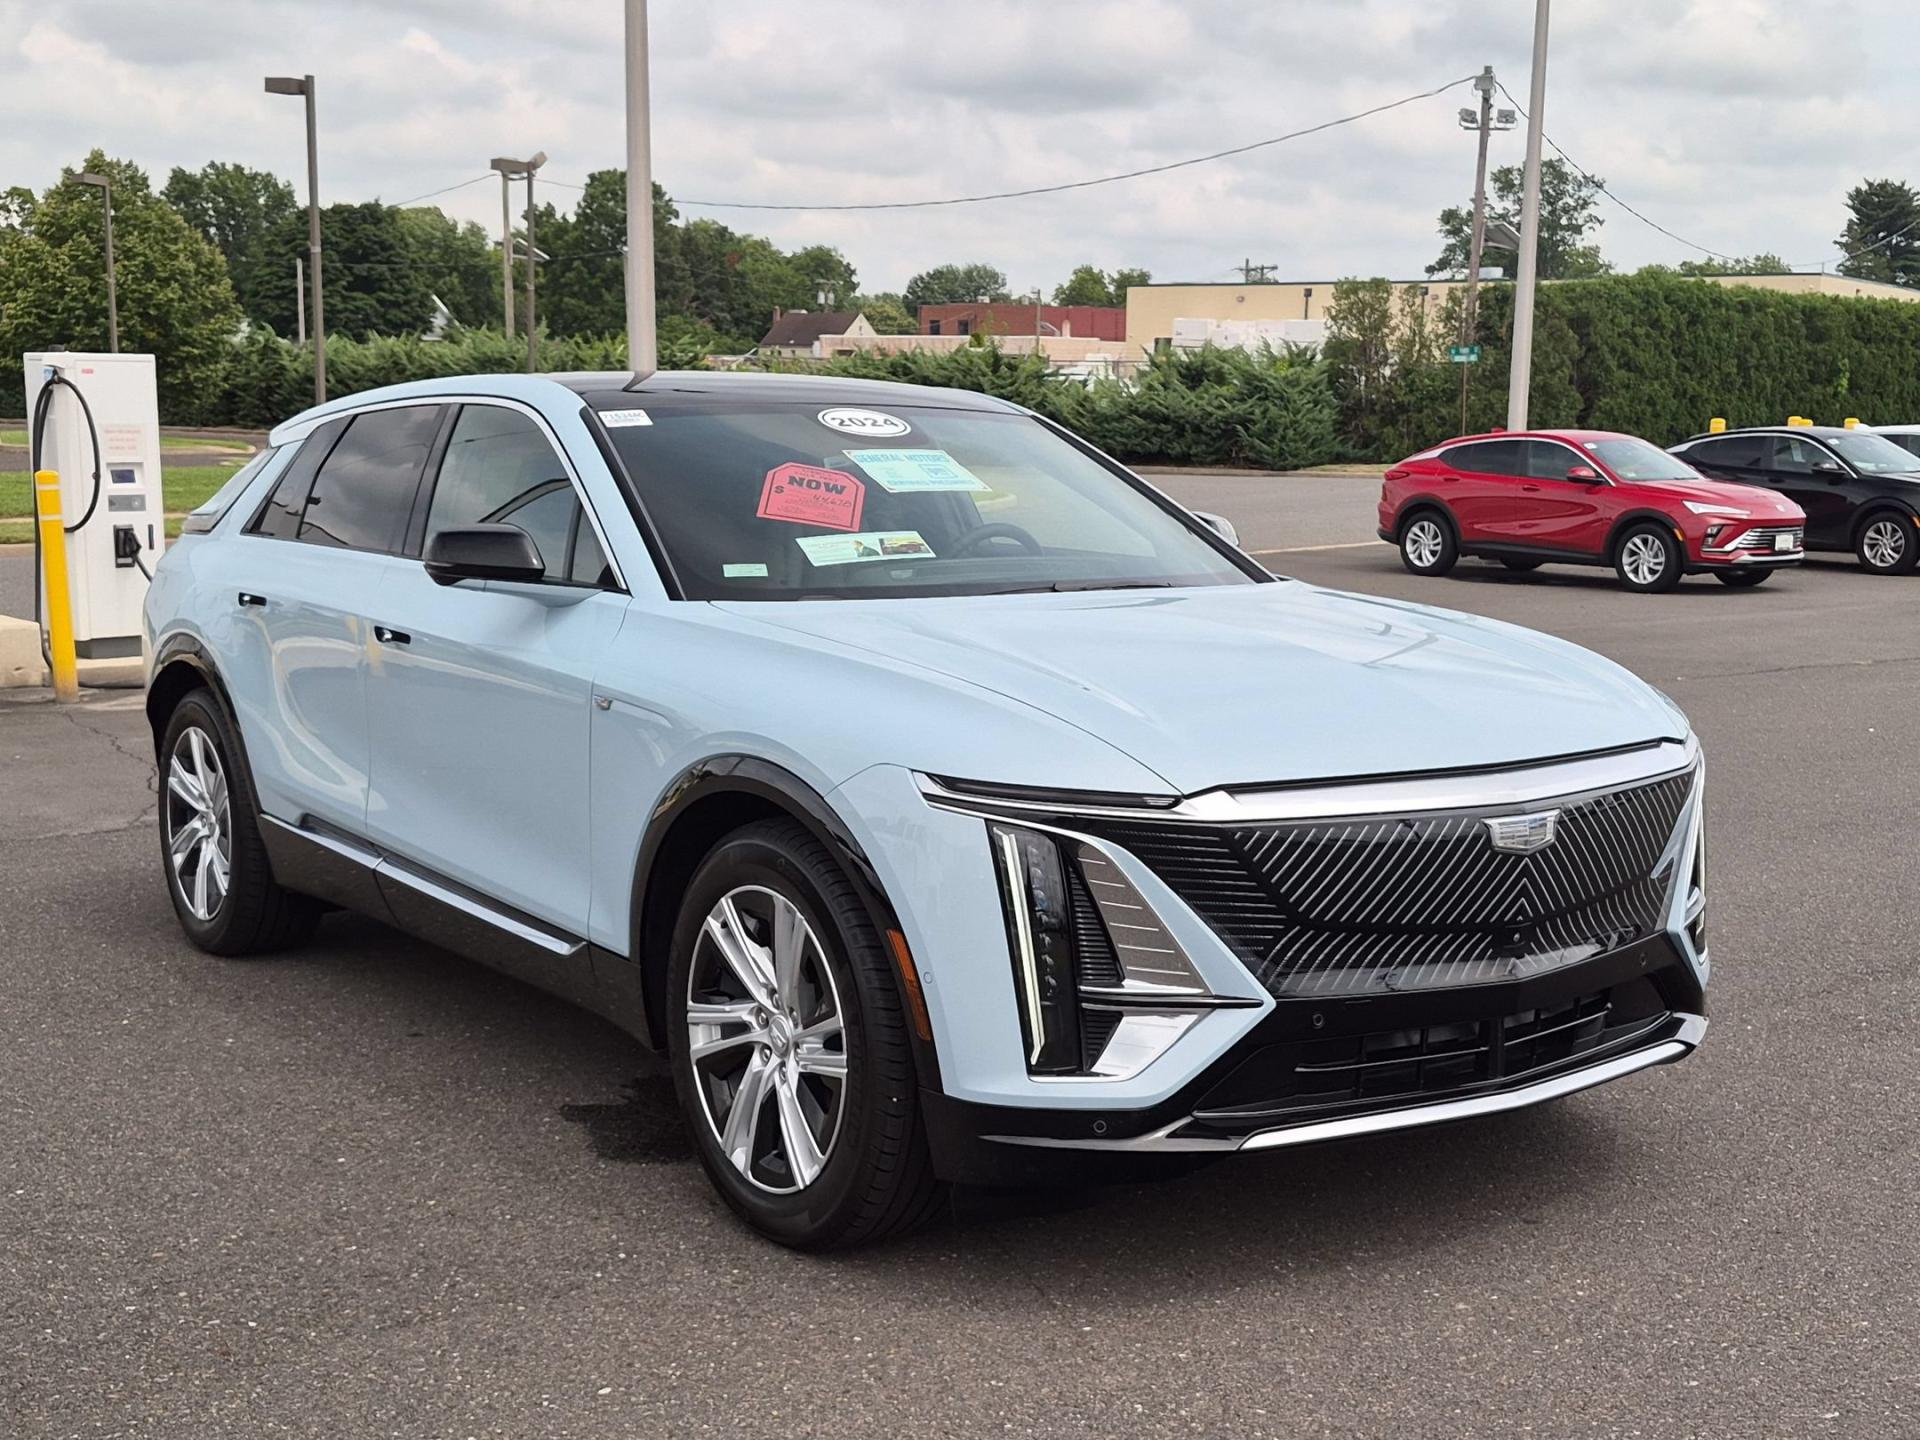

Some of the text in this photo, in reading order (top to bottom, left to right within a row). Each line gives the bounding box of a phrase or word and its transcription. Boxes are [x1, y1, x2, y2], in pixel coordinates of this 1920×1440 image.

[830, 417, 899, 427] 2024
[854, 453, 904, 462] GENERAL
[787, 475, 847, 495] NOW
